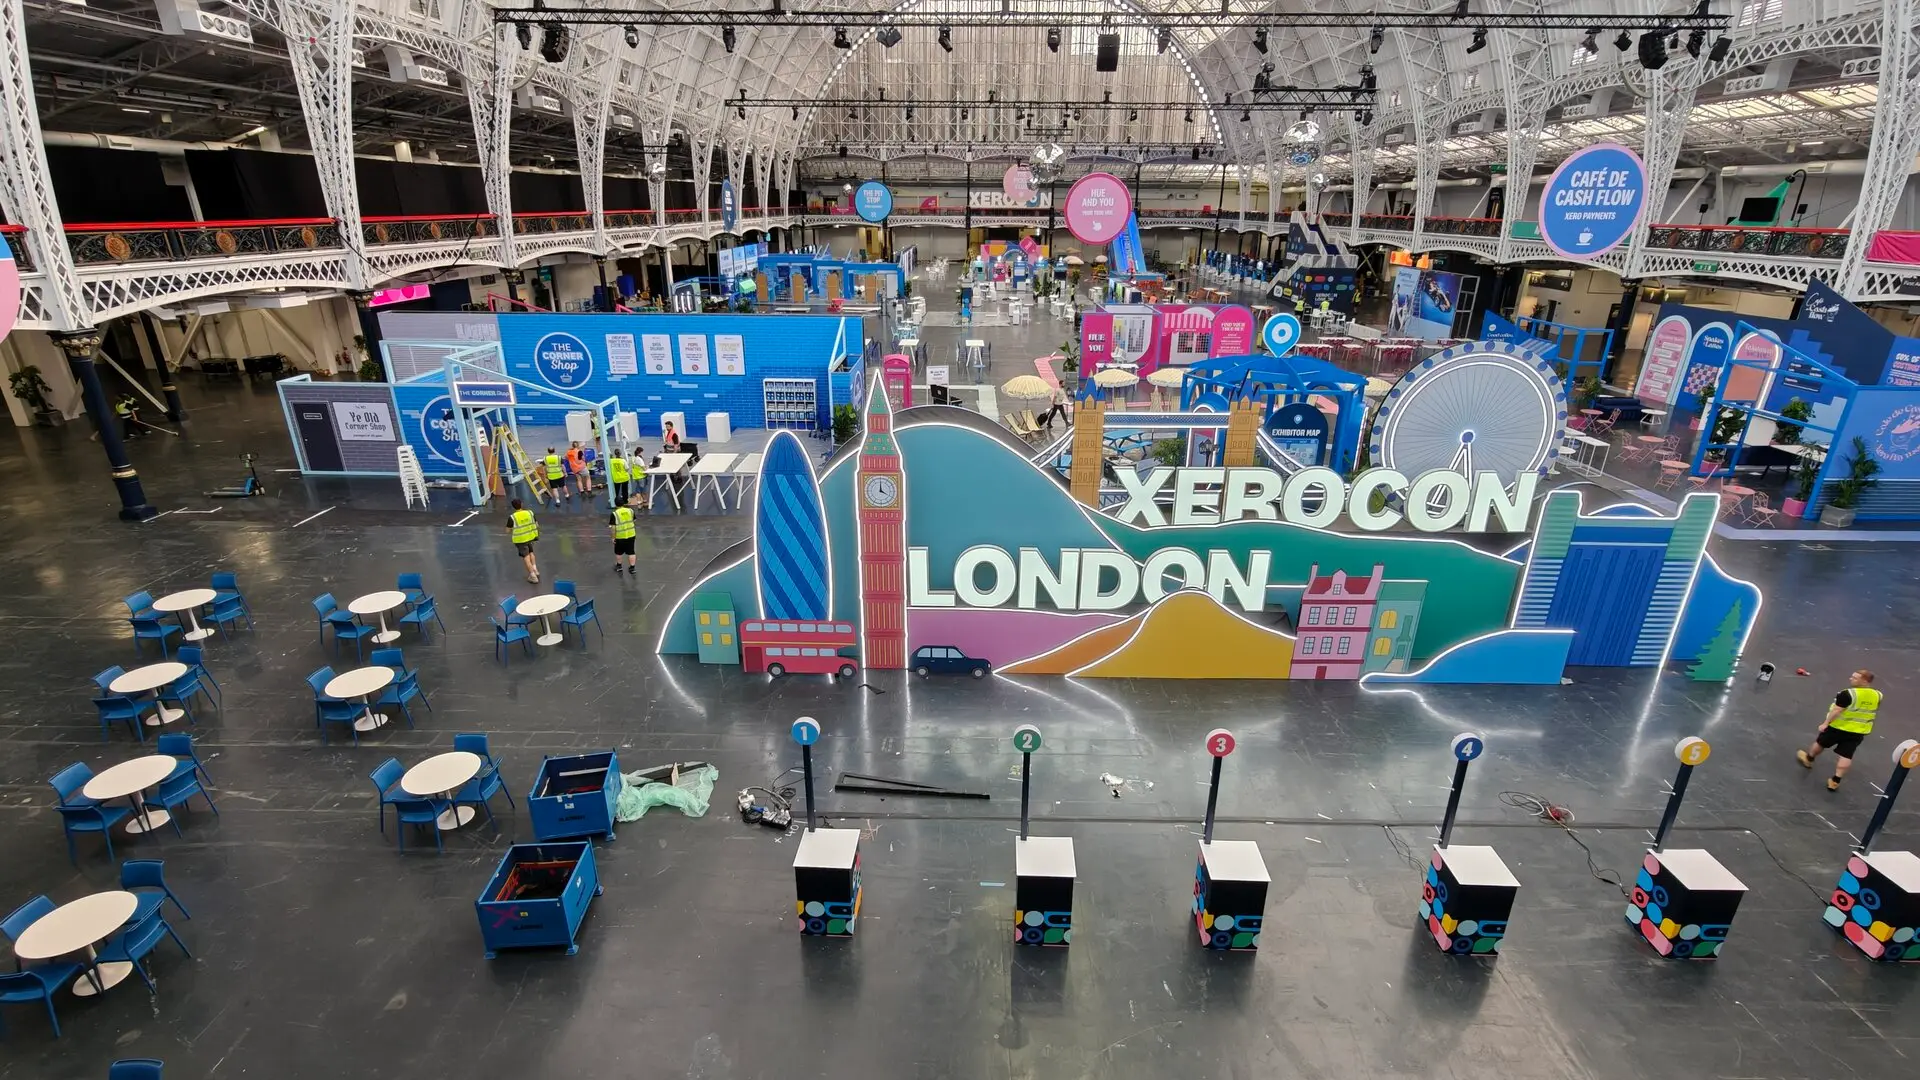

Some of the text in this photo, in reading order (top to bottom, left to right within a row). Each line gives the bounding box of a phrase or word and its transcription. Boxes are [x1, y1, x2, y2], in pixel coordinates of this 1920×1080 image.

[1570, 166, 1630, 187] CAFÉ DE
[1091, 188, 1106, 198] HUE
[1555, 189, 1636, 206] CASH FLOW
[1082, 198, 1115, 207] AND YOU
[1564, 211, 1617, 220] XERO PAYMENTS
[1088, 333, 1105, 341] HUE
[551, 343, 572, 351] THE
[1088, 344, 1105, 352] YOU
[542, 351, 585, 361] CORNER
[551, 360, 580, 373] Shop
[348, 411, 380, 423] Ye Old
[344, 422, 387, 432] Corner Shop
[1271, 428, 1321, 437] EXHIBITOR MAP
[1112, 465, 1540, 533] XEROCON
[909, 545, 1272, 613] LONDON
[800, 725, 808, 741] 1
[1021, 733, 1033, 749] 2
[1215, 737, 1227, 753] 3
[1461, 741, 1474, 757] 4
[1688, 745, 1700, 761] 5
[1908, 748, 1920, 764] 6
